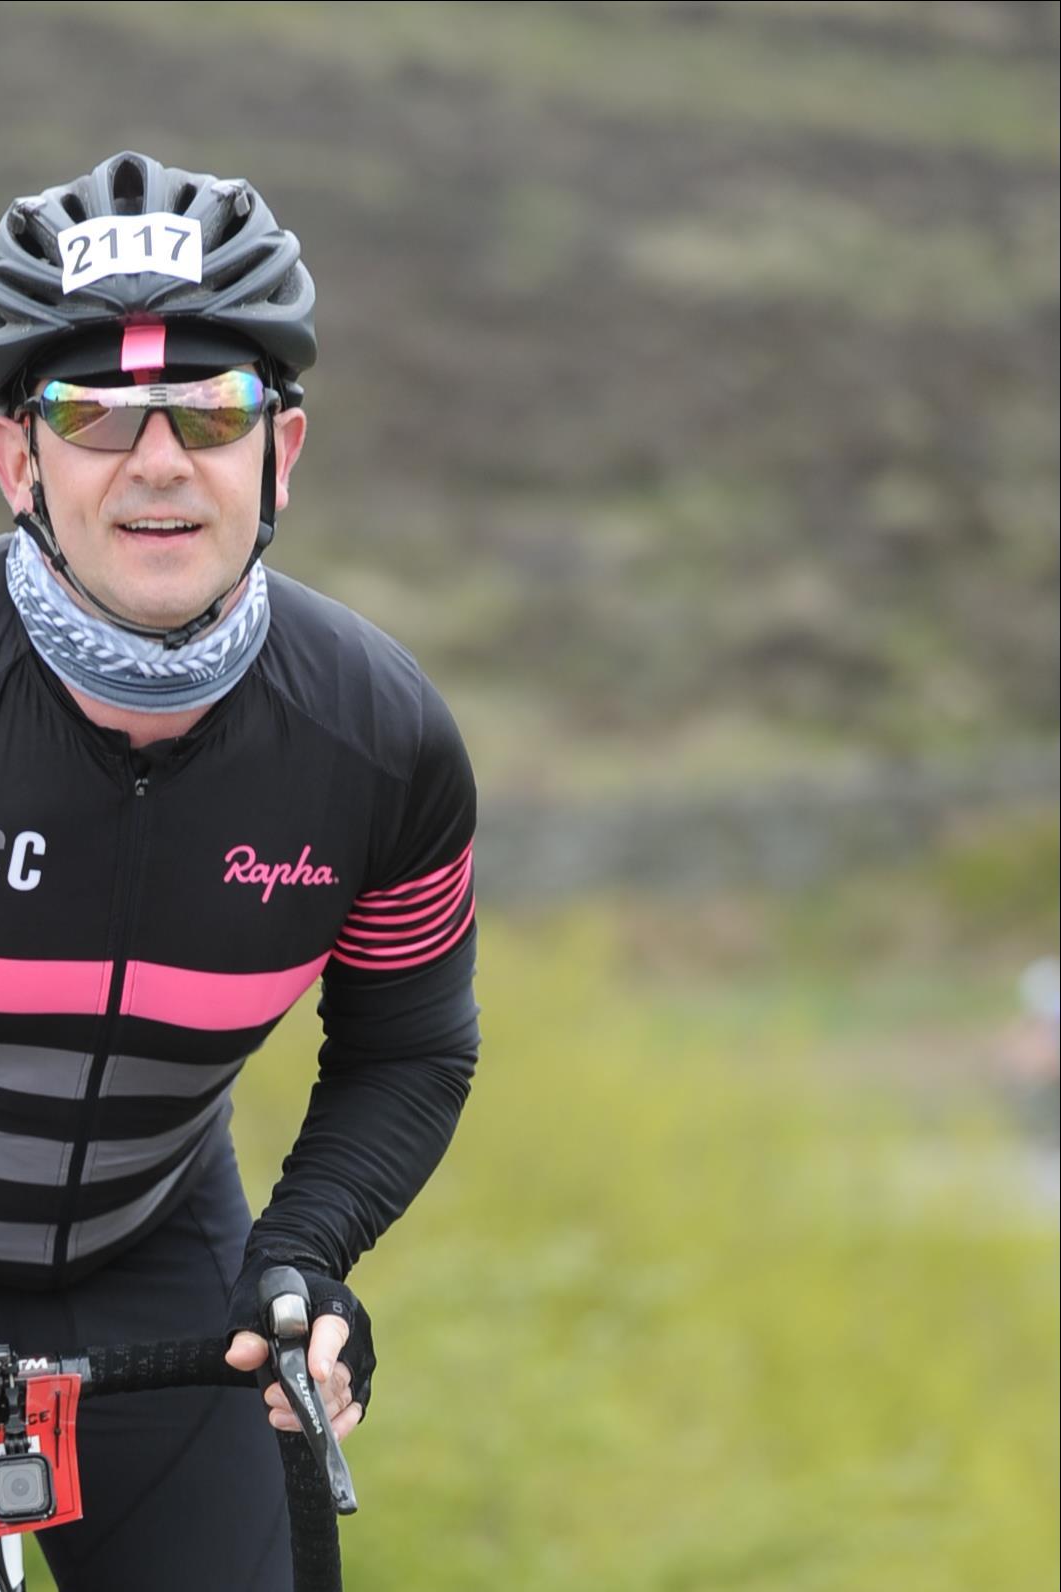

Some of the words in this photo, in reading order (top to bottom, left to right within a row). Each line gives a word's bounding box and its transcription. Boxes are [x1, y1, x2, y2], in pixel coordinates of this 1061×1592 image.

[66, 224, 191, 275] 2117
[27, 1409, 50, 1425] CE
[295, 1372, 324, 1436] ULTEGRA
